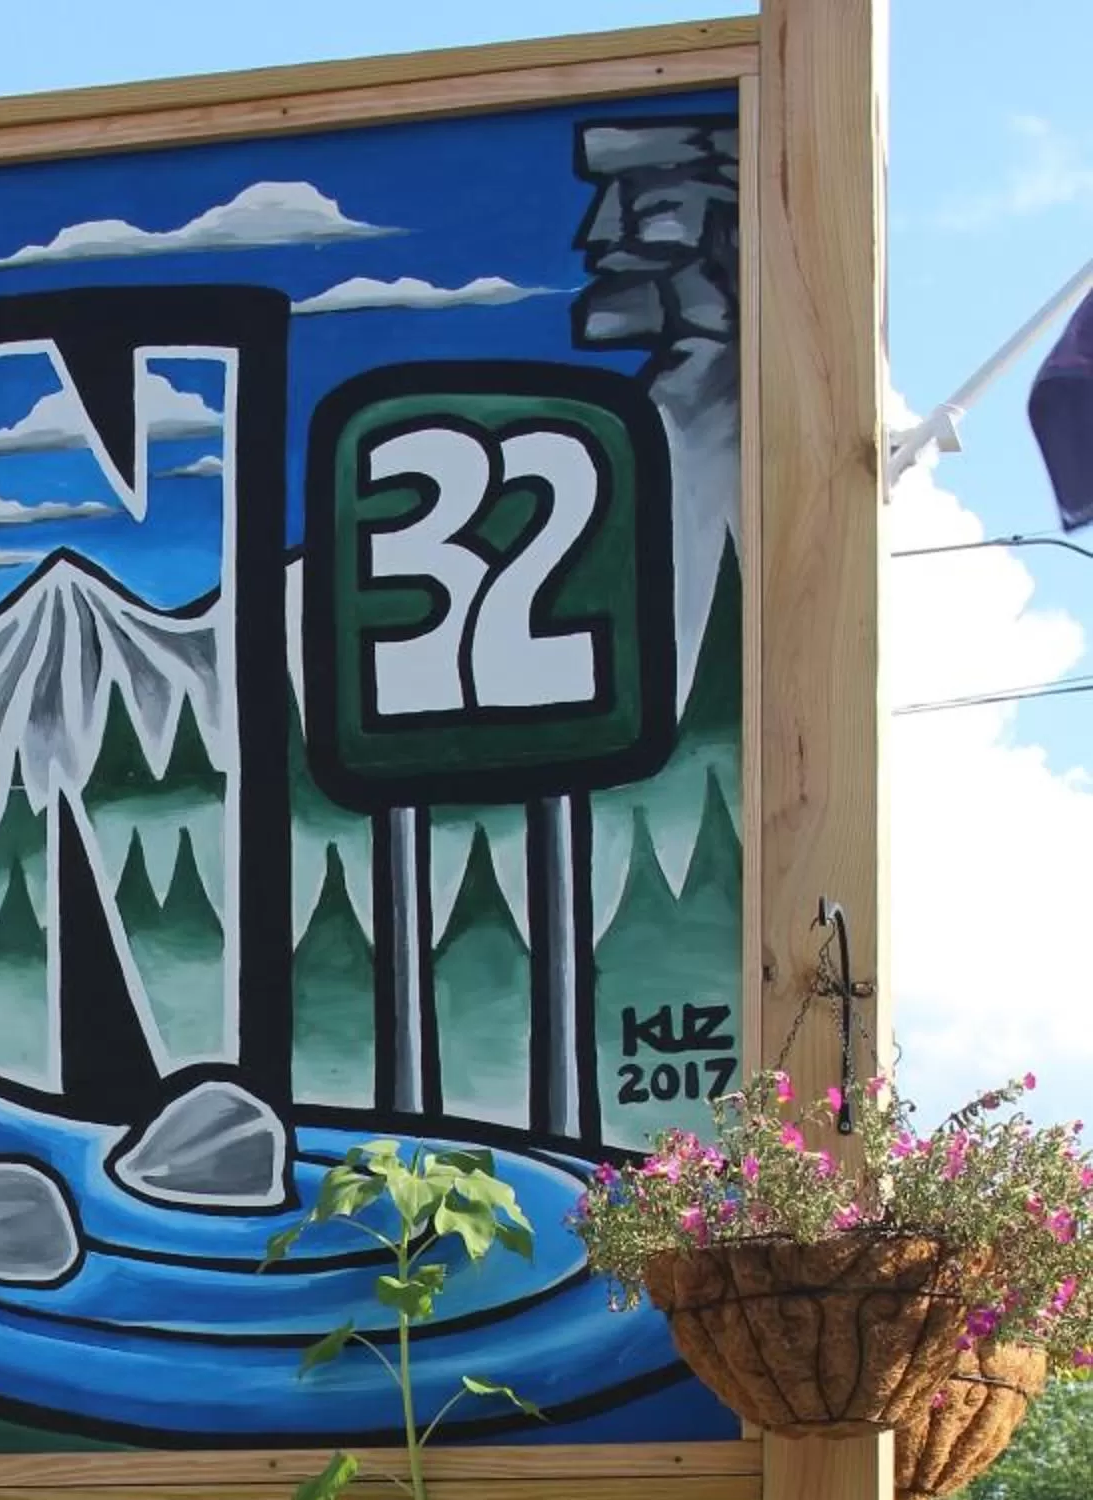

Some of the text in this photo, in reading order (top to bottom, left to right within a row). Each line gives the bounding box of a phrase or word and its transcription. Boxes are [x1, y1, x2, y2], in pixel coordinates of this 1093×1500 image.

[368, 427, 599, 715] 32
[621, 1002, 735, 1057] KUZ
[616, 1057, 738, 1105] 2017
